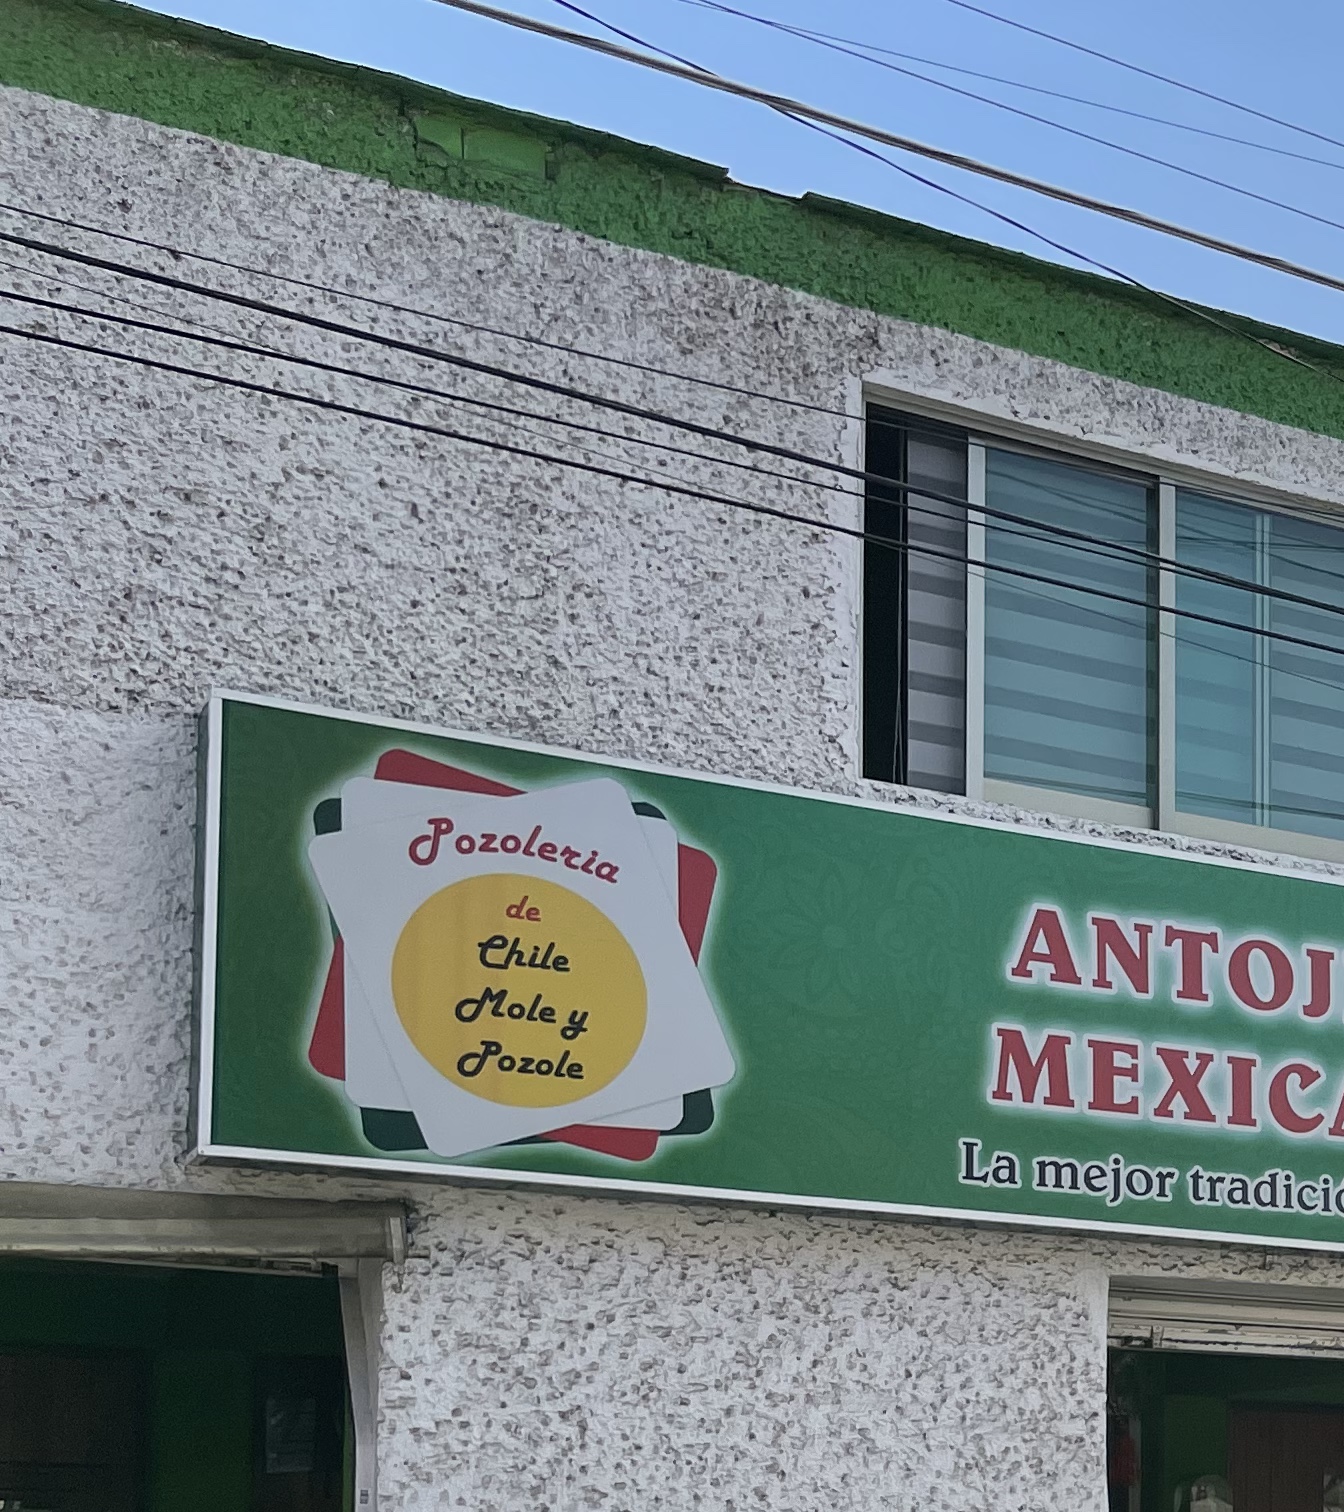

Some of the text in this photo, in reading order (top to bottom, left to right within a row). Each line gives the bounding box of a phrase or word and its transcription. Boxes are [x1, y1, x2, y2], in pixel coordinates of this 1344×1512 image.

[407, 816, 621, 884] Pozoleria
[505, 895, 543, 922] de
[477, 934, 571, 973] Chile
[454, 986, 590, 1041] Mole y
[455, 1040, 586, 1081] Pozole
[960, 1140, 1019, 1187] La
[1035, 1157, 1176, 1205] mejor
